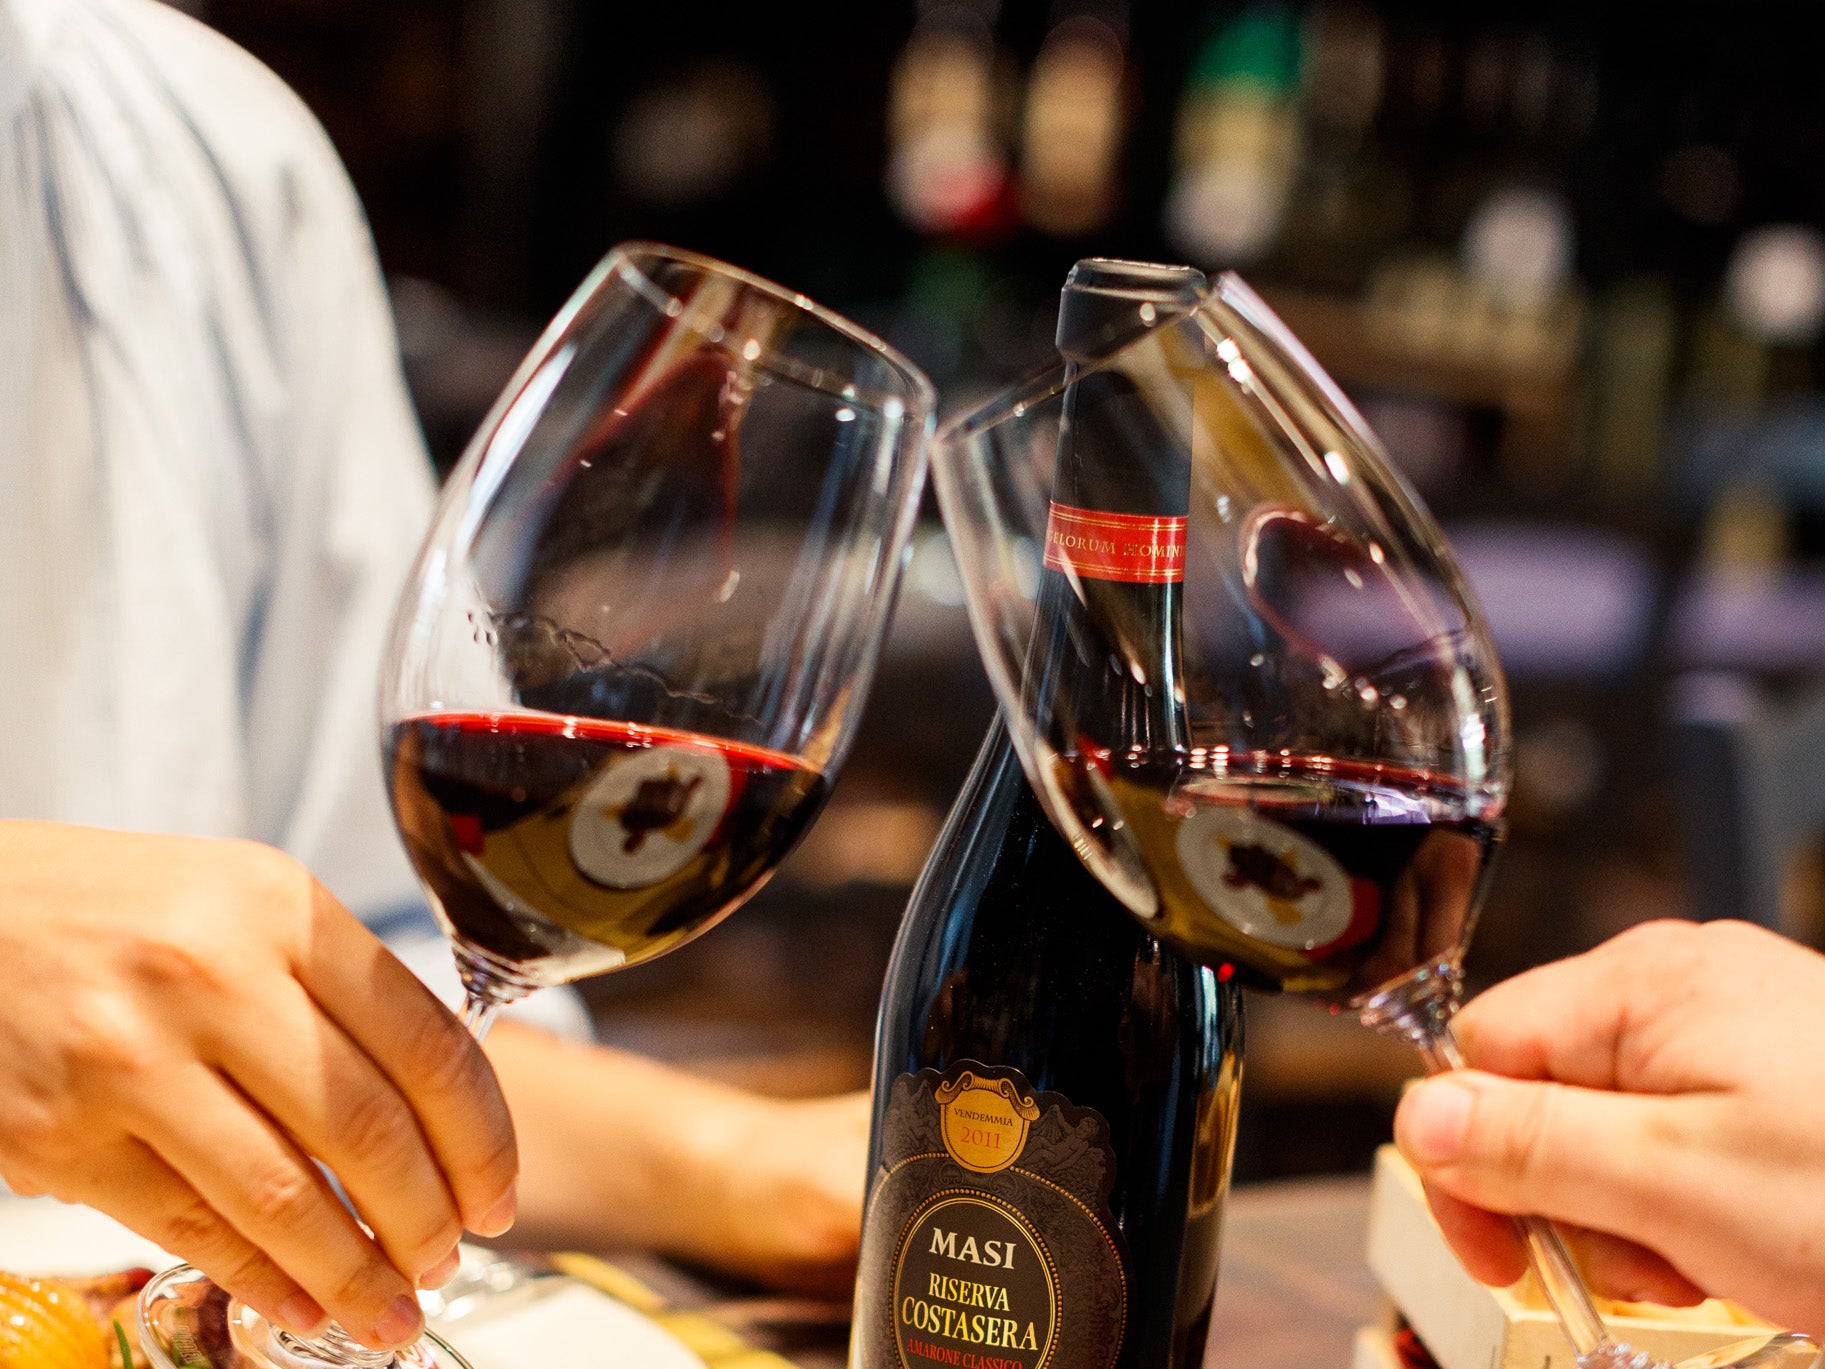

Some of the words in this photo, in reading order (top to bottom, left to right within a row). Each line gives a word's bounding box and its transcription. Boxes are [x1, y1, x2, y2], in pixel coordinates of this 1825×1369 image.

[954, 1107, 1013, 1126] VENDEMMIA
[961, 1126, 1001, 1149] 2011
[929, 1227, 1017, 1270] MASI
[928, 1272, 1010, 1312] RISERVA
[902, 1296, 1038, 1350] COSTASERA
[908, 1338, 961, 1366] AMARONE
